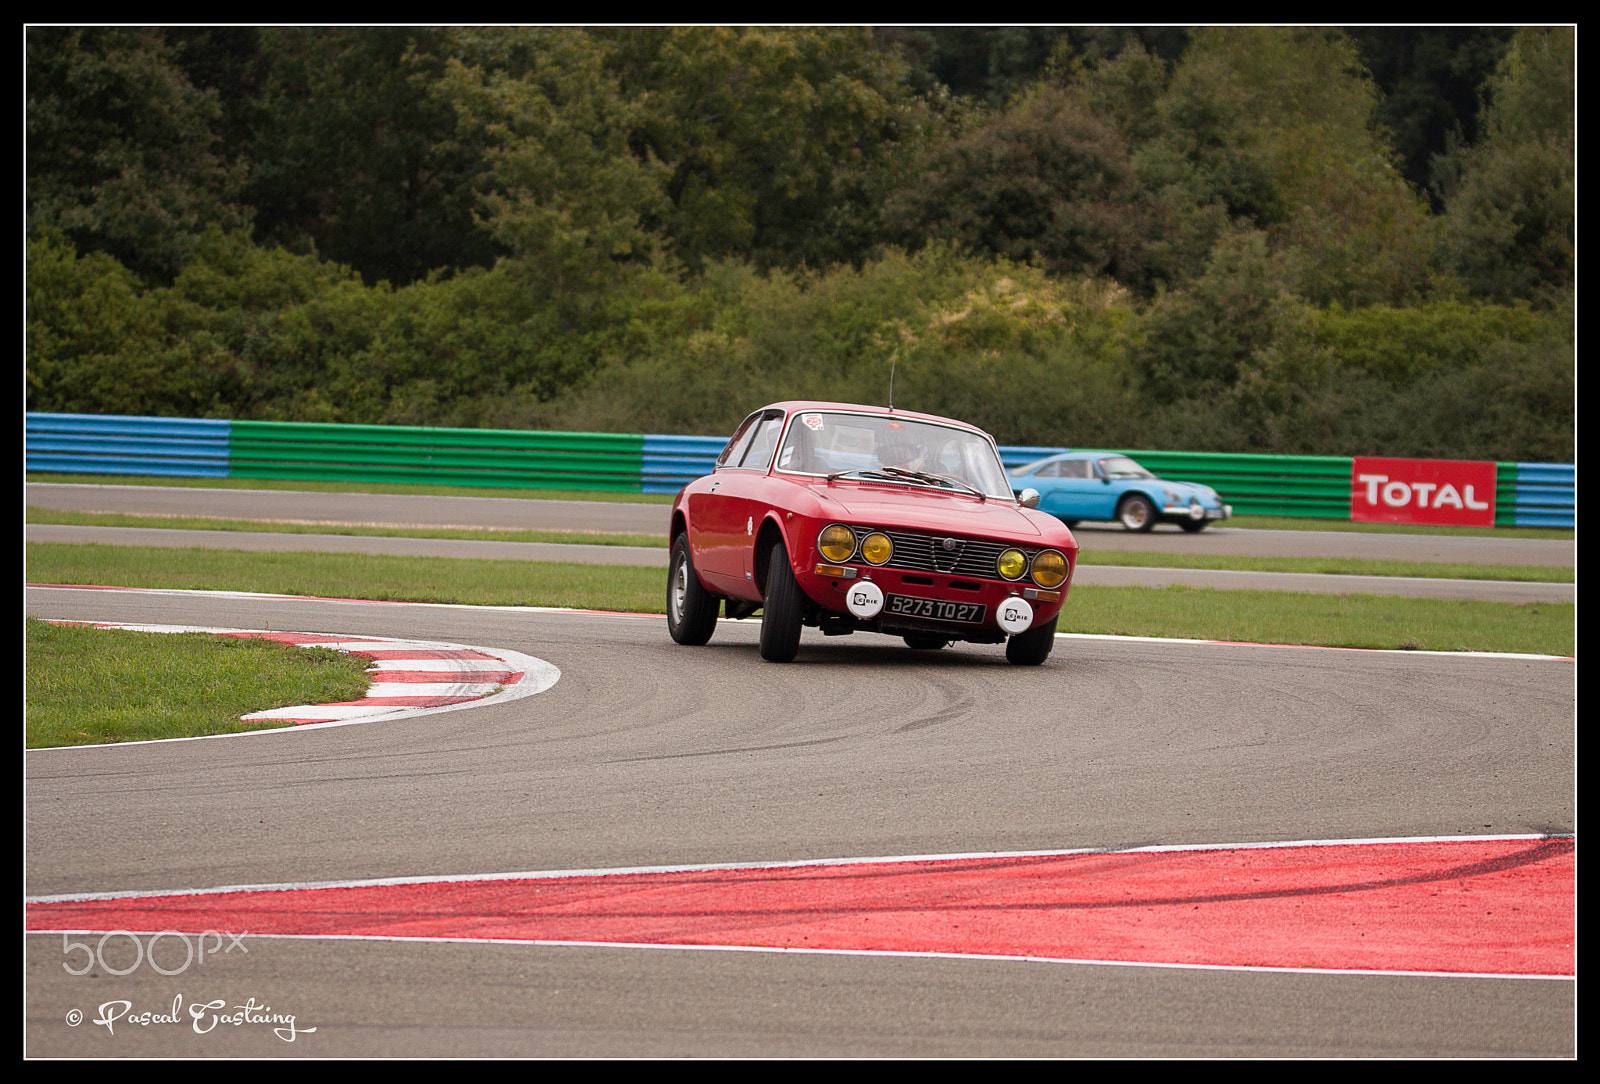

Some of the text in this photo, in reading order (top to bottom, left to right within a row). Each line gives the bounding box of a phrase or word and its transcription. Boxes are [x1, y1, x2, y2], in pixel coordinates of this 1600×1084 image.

[1359, 474, 1489, 510] TOTAL
[892, 597, 979, 621] 5273 TQ 27
